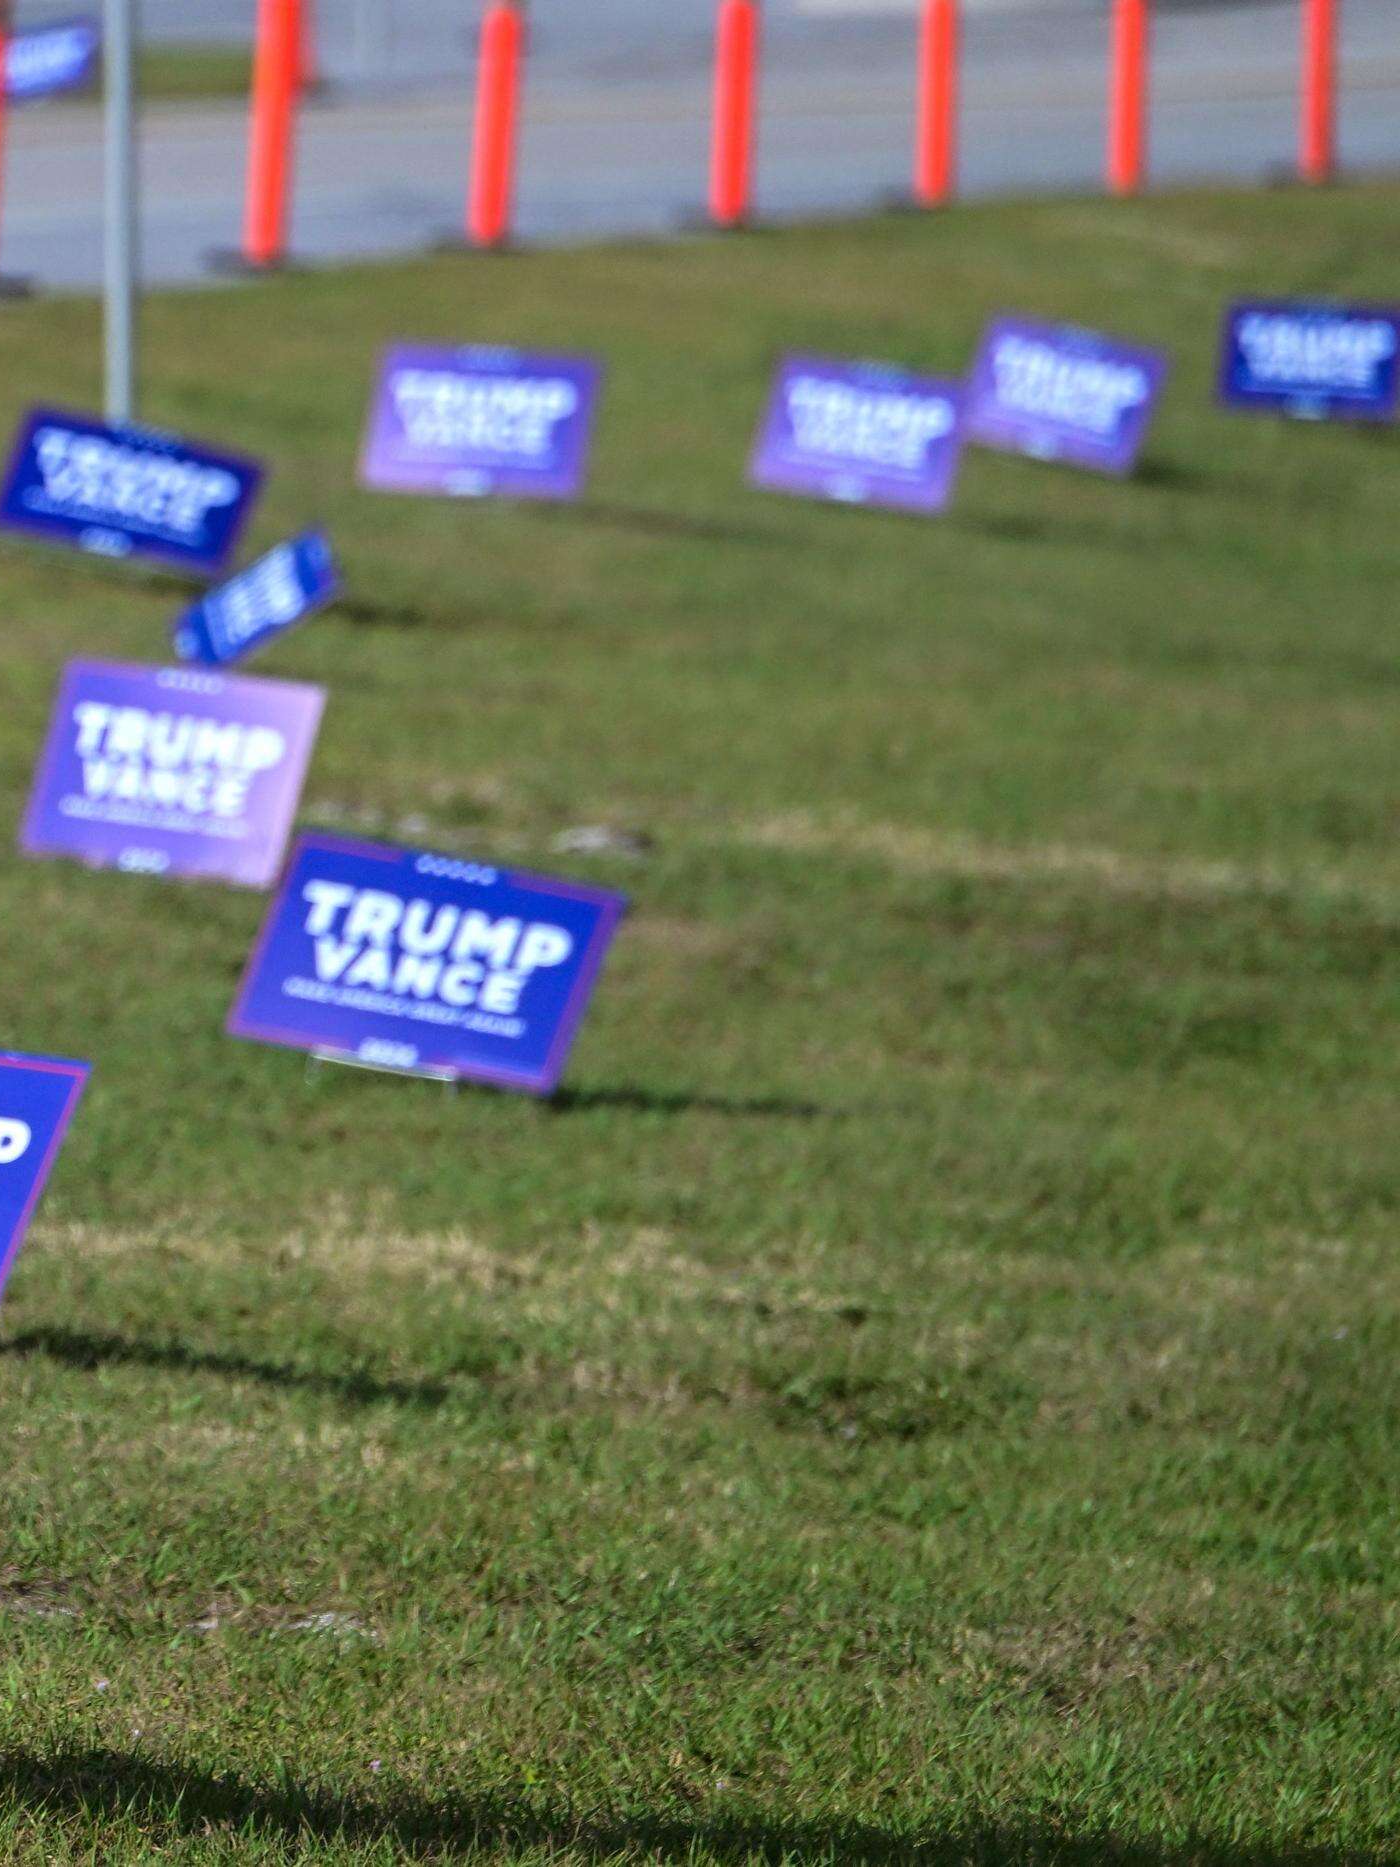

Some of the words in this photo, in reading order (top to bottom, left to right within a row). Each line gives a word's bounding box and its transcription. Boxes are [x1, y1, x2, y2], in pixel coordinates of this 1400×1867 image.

[74, 702, 285, 771] TRUMP
[303, 878, 573, 975] TRUMP
[314, 933, 529, 1015] VANCE
